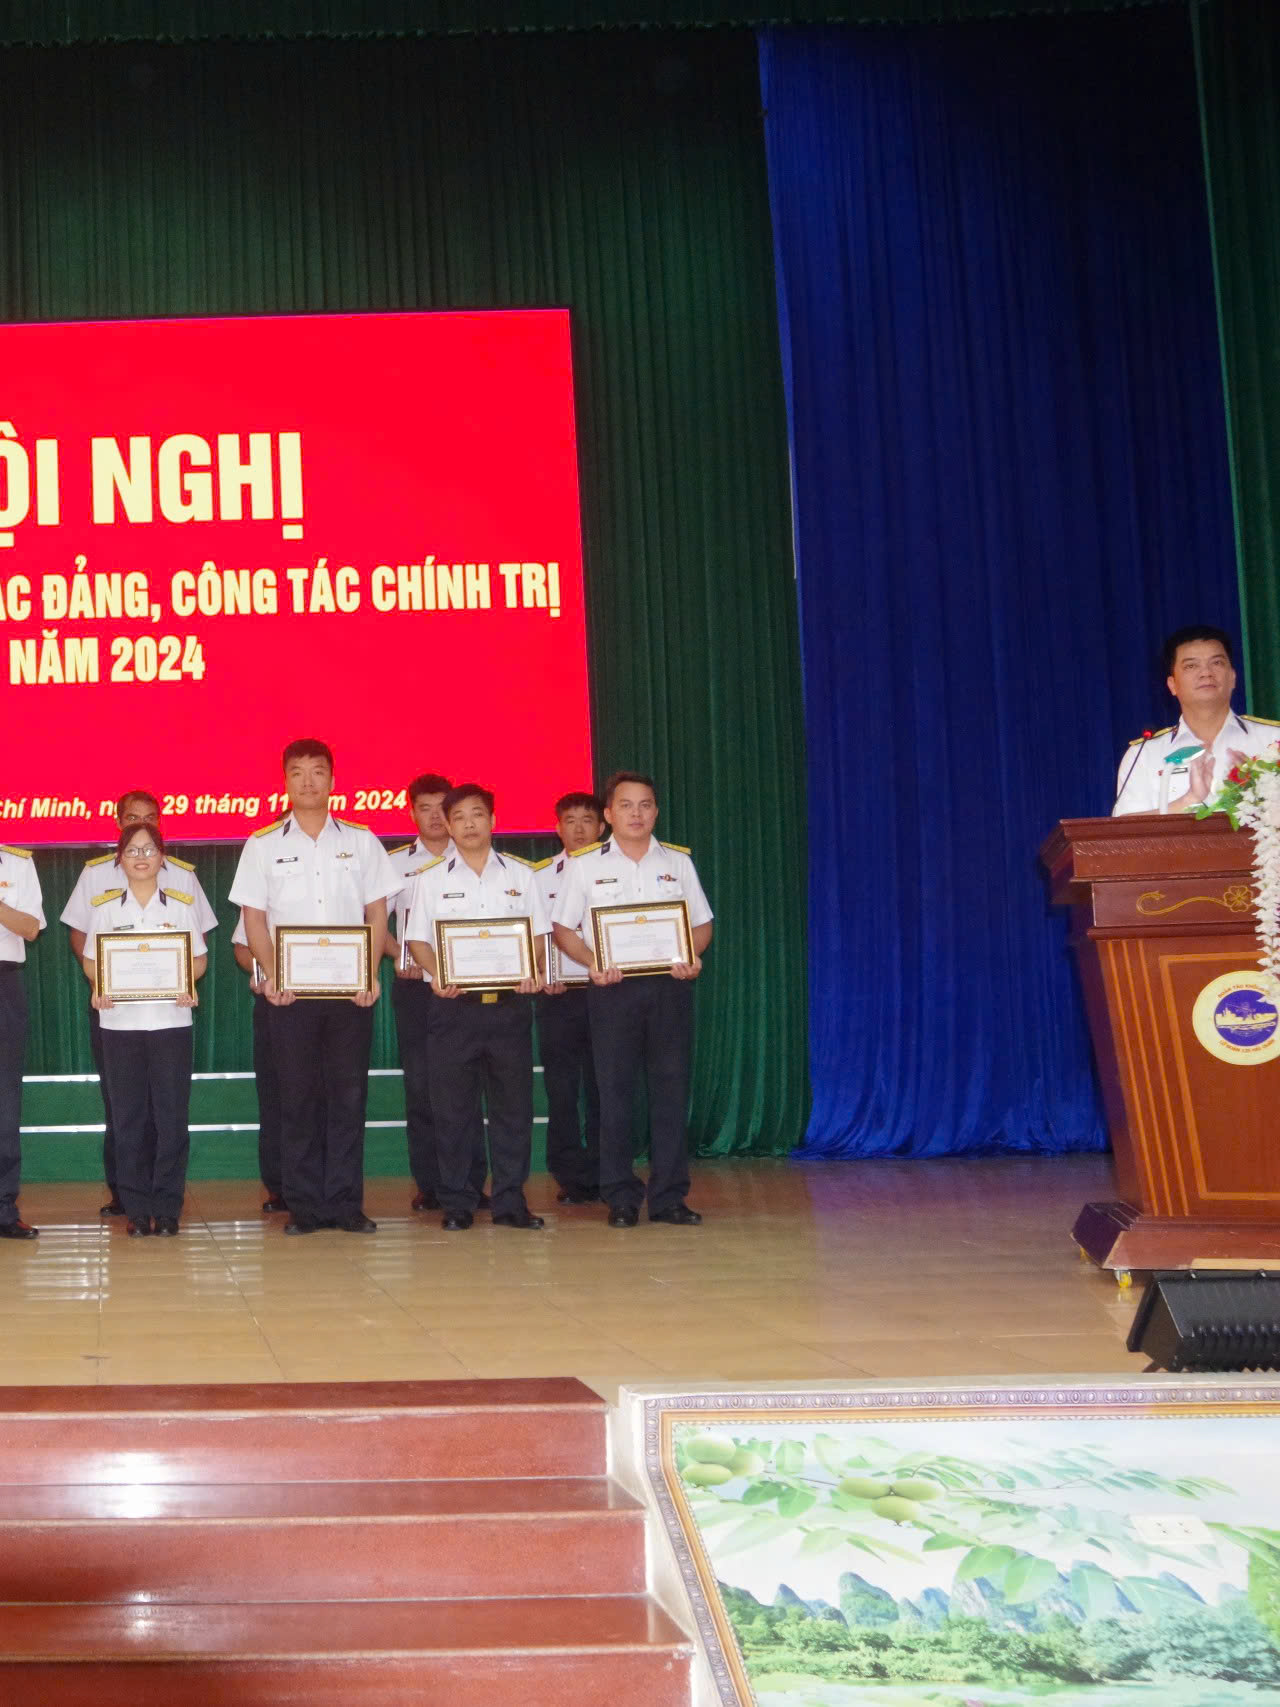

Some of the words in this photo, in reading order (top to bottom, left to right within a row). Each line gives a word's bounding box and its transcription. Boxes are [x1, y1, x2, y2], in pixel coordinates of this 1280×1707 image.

[91, 431, 304, 540] NGHỊ
[41, 554, 161, 623] ĐẢNG,
[171, 560, 278, 617] CÔNG
[286, 557, 361, 614] TÁC
[371, 555, 491, 612] CHÍNH
[498, 562, 561, 618] TRỊ
[9, 628, 100, 685] NĂM
[110, 635, 206, 683] 2024
[0, 797, 28, 819] hí
[30, 797, 92, 820] Minh,
[161, 794, 189, 815] 29
[195, 793, 260, 818] tháng
[267, 792, 289, 813] 11
[354, 789, 407, 811] 2024
